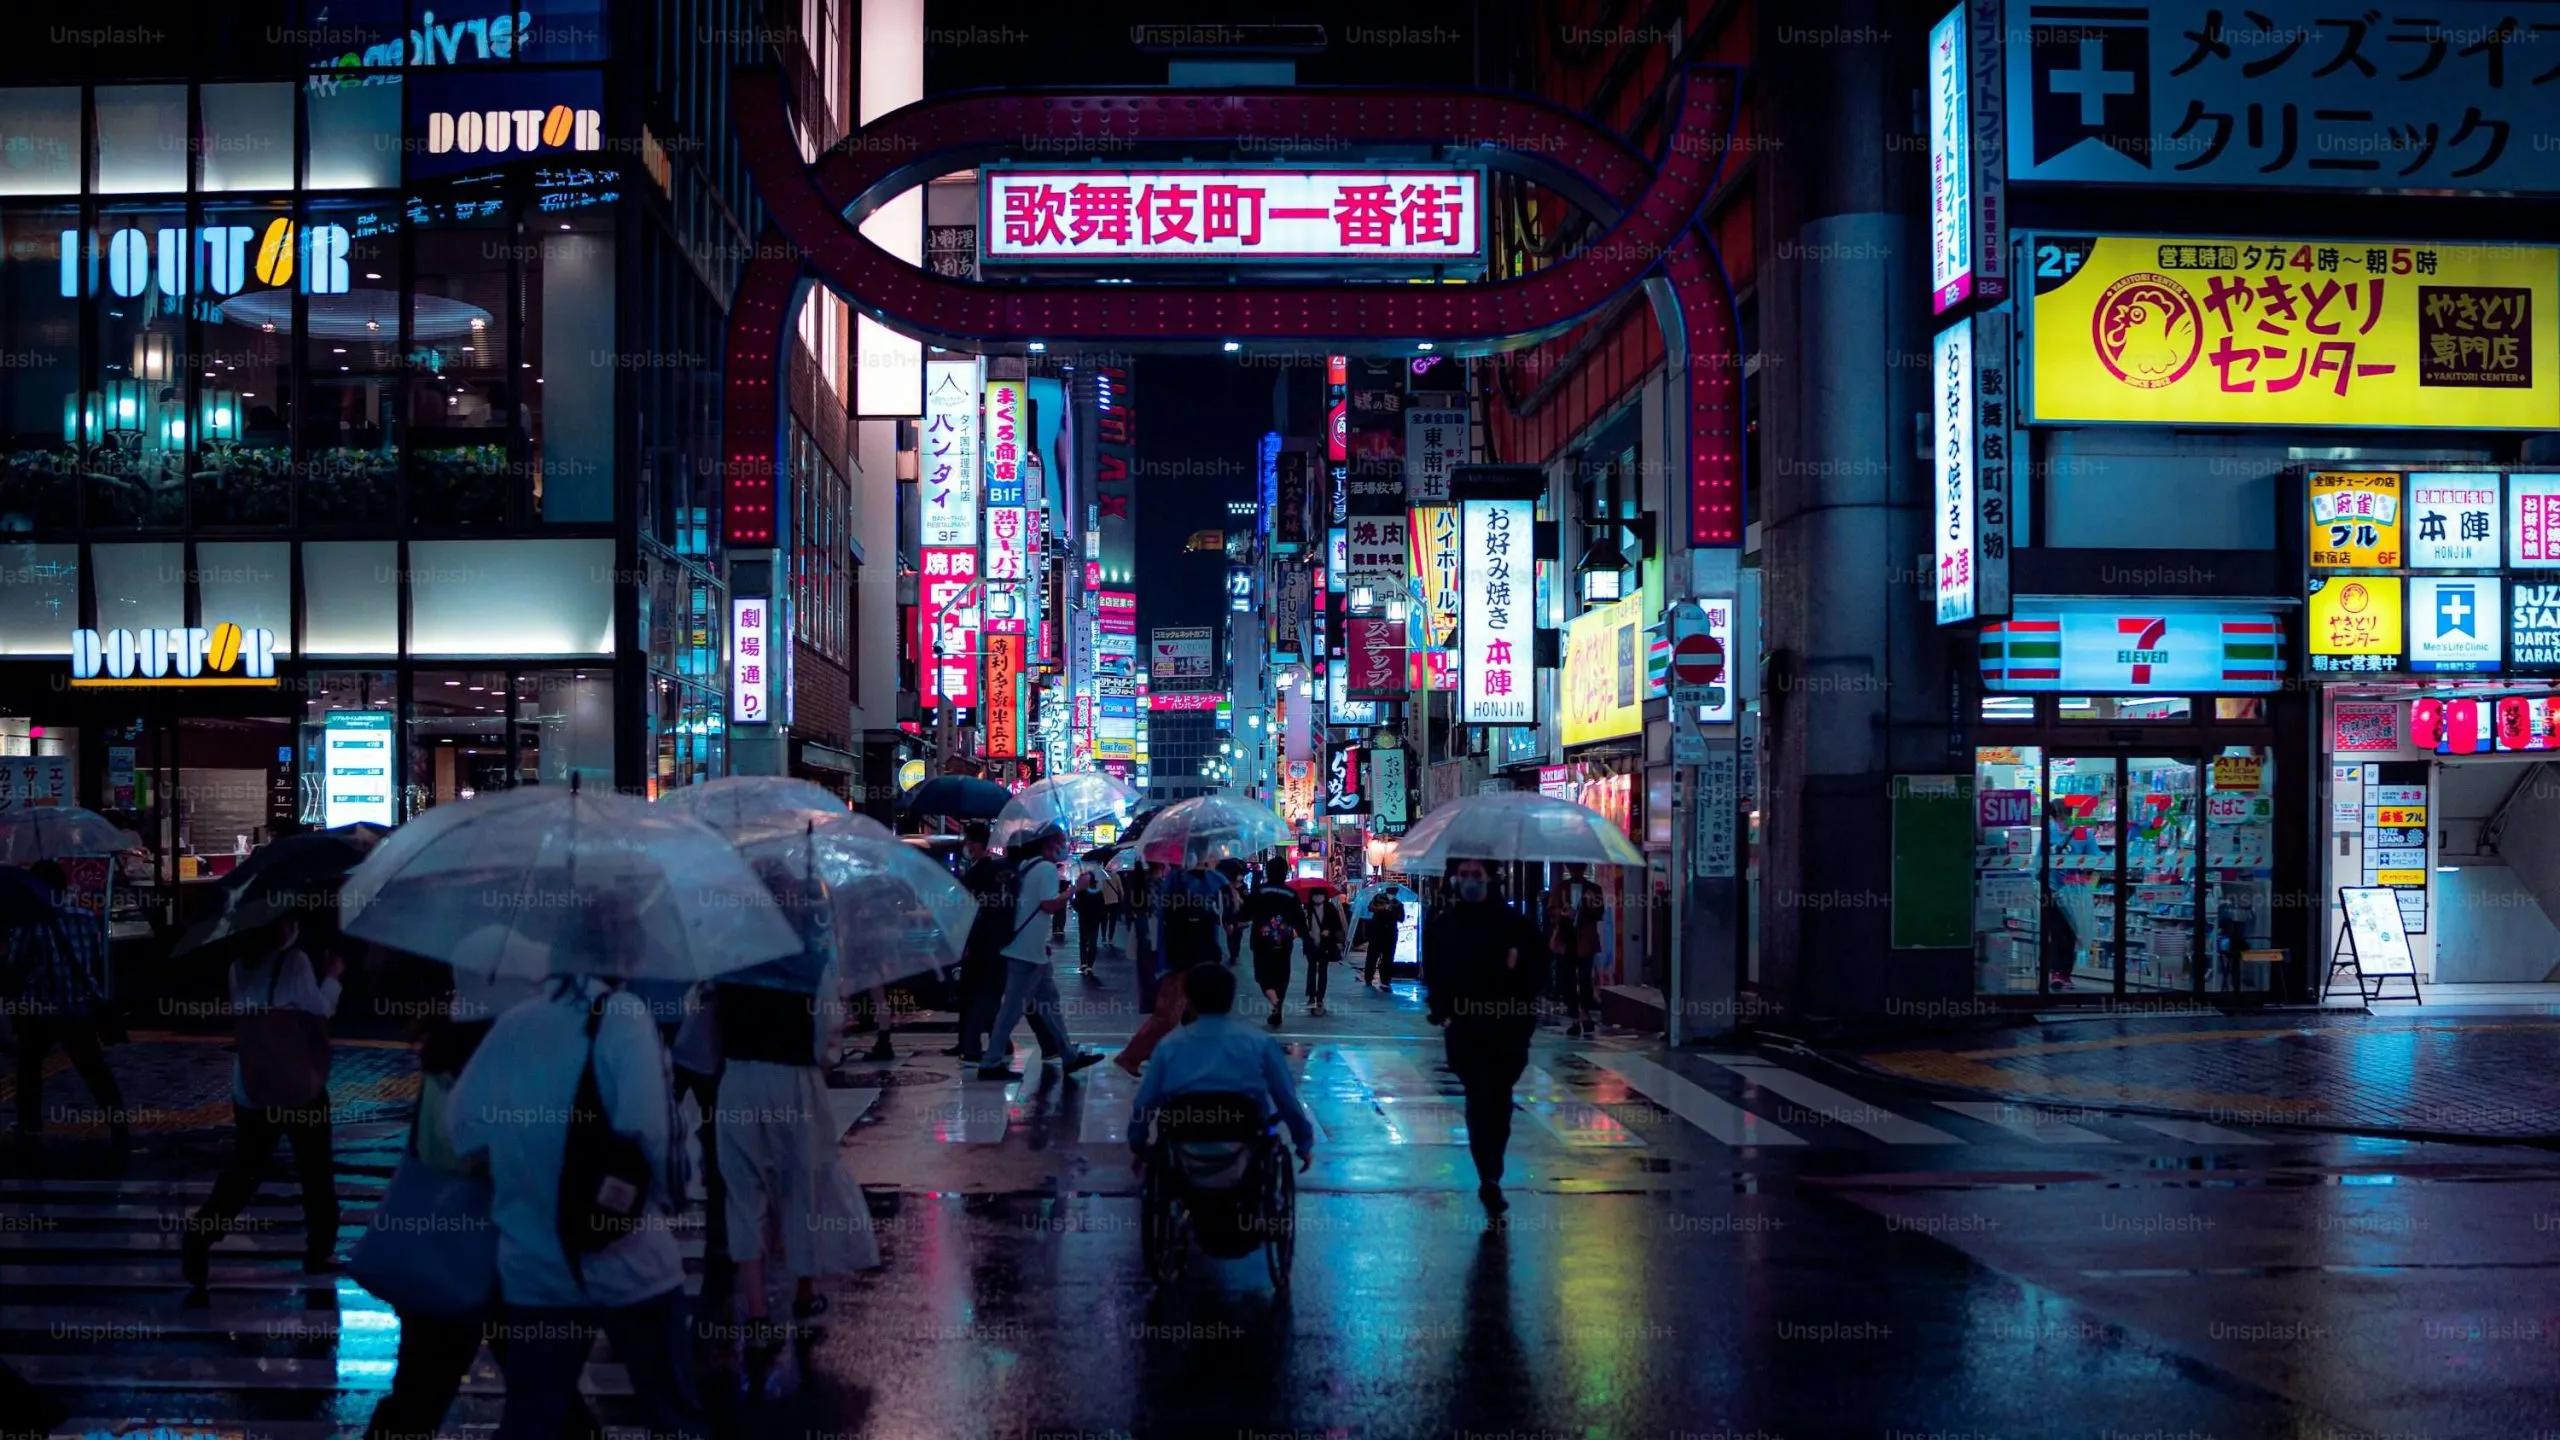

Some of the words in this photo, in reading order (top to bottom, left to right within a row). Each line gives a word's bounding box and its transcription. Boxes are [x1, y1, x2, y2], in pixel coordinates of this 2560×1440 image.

[428, 104, 600, 154] DOUTOR
[2172, 100, 2512, 178] クリニック
[1004, 183, 1463, 247] 歌舞伎町一番街
[2037, 246, 2080, 278] 2F
[2161, 249, 2237, 269] 営業時間
[2203, 276, 2384, 338] やきとり
[2426, 293, 2525, 330] やきとり
[2430, 333, 2520, 370] 専門店
[2209, 335, 2398, 397] センター
[2434, 373, 2478, 382] YAKITORI
[2480, 374, 2519, 383] CENTER
[995, 387, 1019, 480] まぐろ商店
[928, 414, 954, 508] バンタイ
[1424, 428, 1443, 497] 東南荘
[1980, 367, 2005, 560] 歌舞伎町名物
[2314, 475, 2395, 488] 全国チェーンの店
[989, 488, 1022, 502] B1F
[2335, 492, 2374, 515] 麻雀
[1353, 521, 1404, 546] 焼肉
[2330, 524, 2378, 548] ブル
[2418, 510, 2491, 542] 本陣
[937, 531, 959, 546] 3F
[924, 552, 974, 575] 焼肉
[1437, 511, 1456, 609] ハイボール
[2313, 551, 2351, 565] 新宿店
[2378, 551, 2397, 565] 6F
[2434, 546, 2473, 560] HONJIN
[1485, 507, 1512, 630] お好み焼き
[2514, 584, 2560, 608] BUZ
[997, 620, 1016, 632] 4F
[2329, 616, 2377, 632] やきとり
[72, 622, 276, 679] DOUTOR
[2330, 632, 2380, 648] センター
[2465, 642, 2489, 652] Clinic
[740, 608, 761, 712] 劇場通り
[1364, 621, 1393, 687] ステップ
[2116, 650, 2169, 664] ELEVEN
[2312, 654, 2398, 672] 朝まで営業中
[1485, 637, 1512, 696] 本陣
[1436, 673, 1458, 687] 2F
[1472, 701, 1525, 717] HONJIN
[2215, 757, 2262, 767] ATM
[1984, 797, 2029, 822] SIM
[2208, 799, 2246, 816] たばこ
